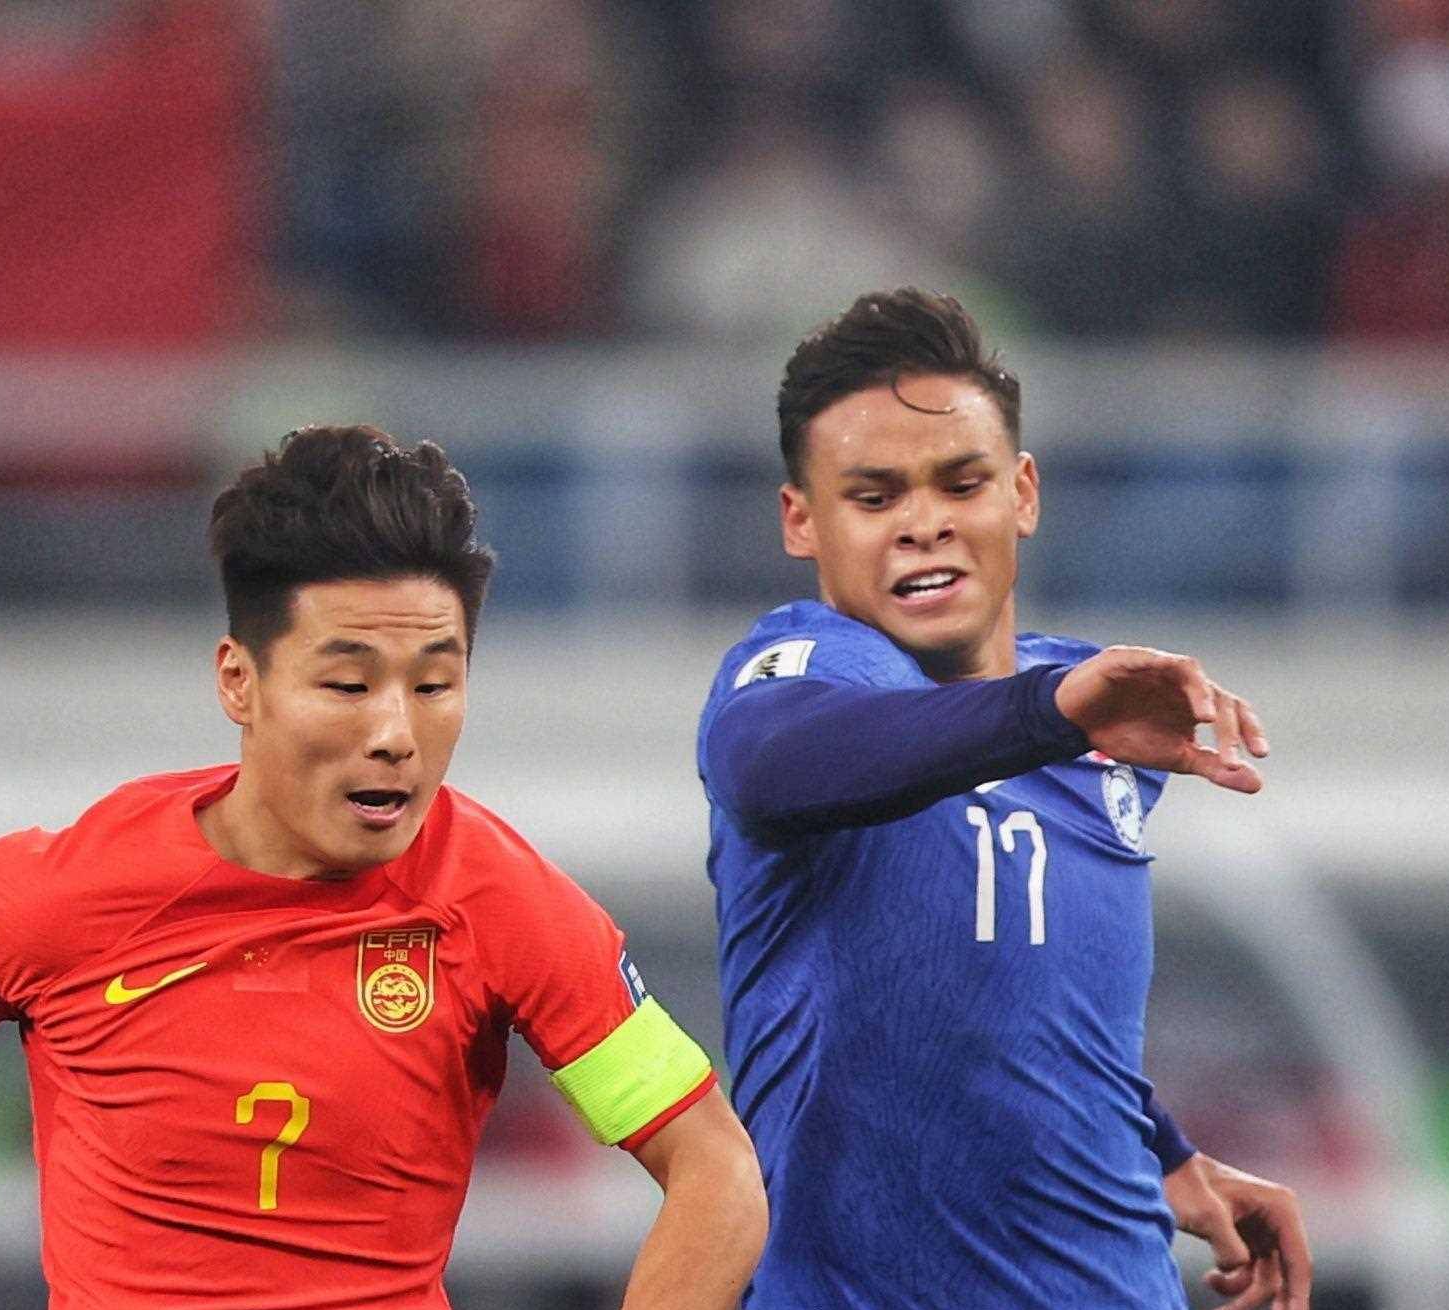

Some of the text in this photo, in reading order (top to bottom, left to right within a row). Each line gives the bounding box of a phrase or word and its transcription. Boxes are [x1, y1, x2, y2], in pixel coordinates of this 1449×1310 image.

[966, 805, 1047, 946] 17
[366, 933, 428, 949] CFA
[383, 949, 409, 962] 中国
[236, 1082, 310, 1210] 7
